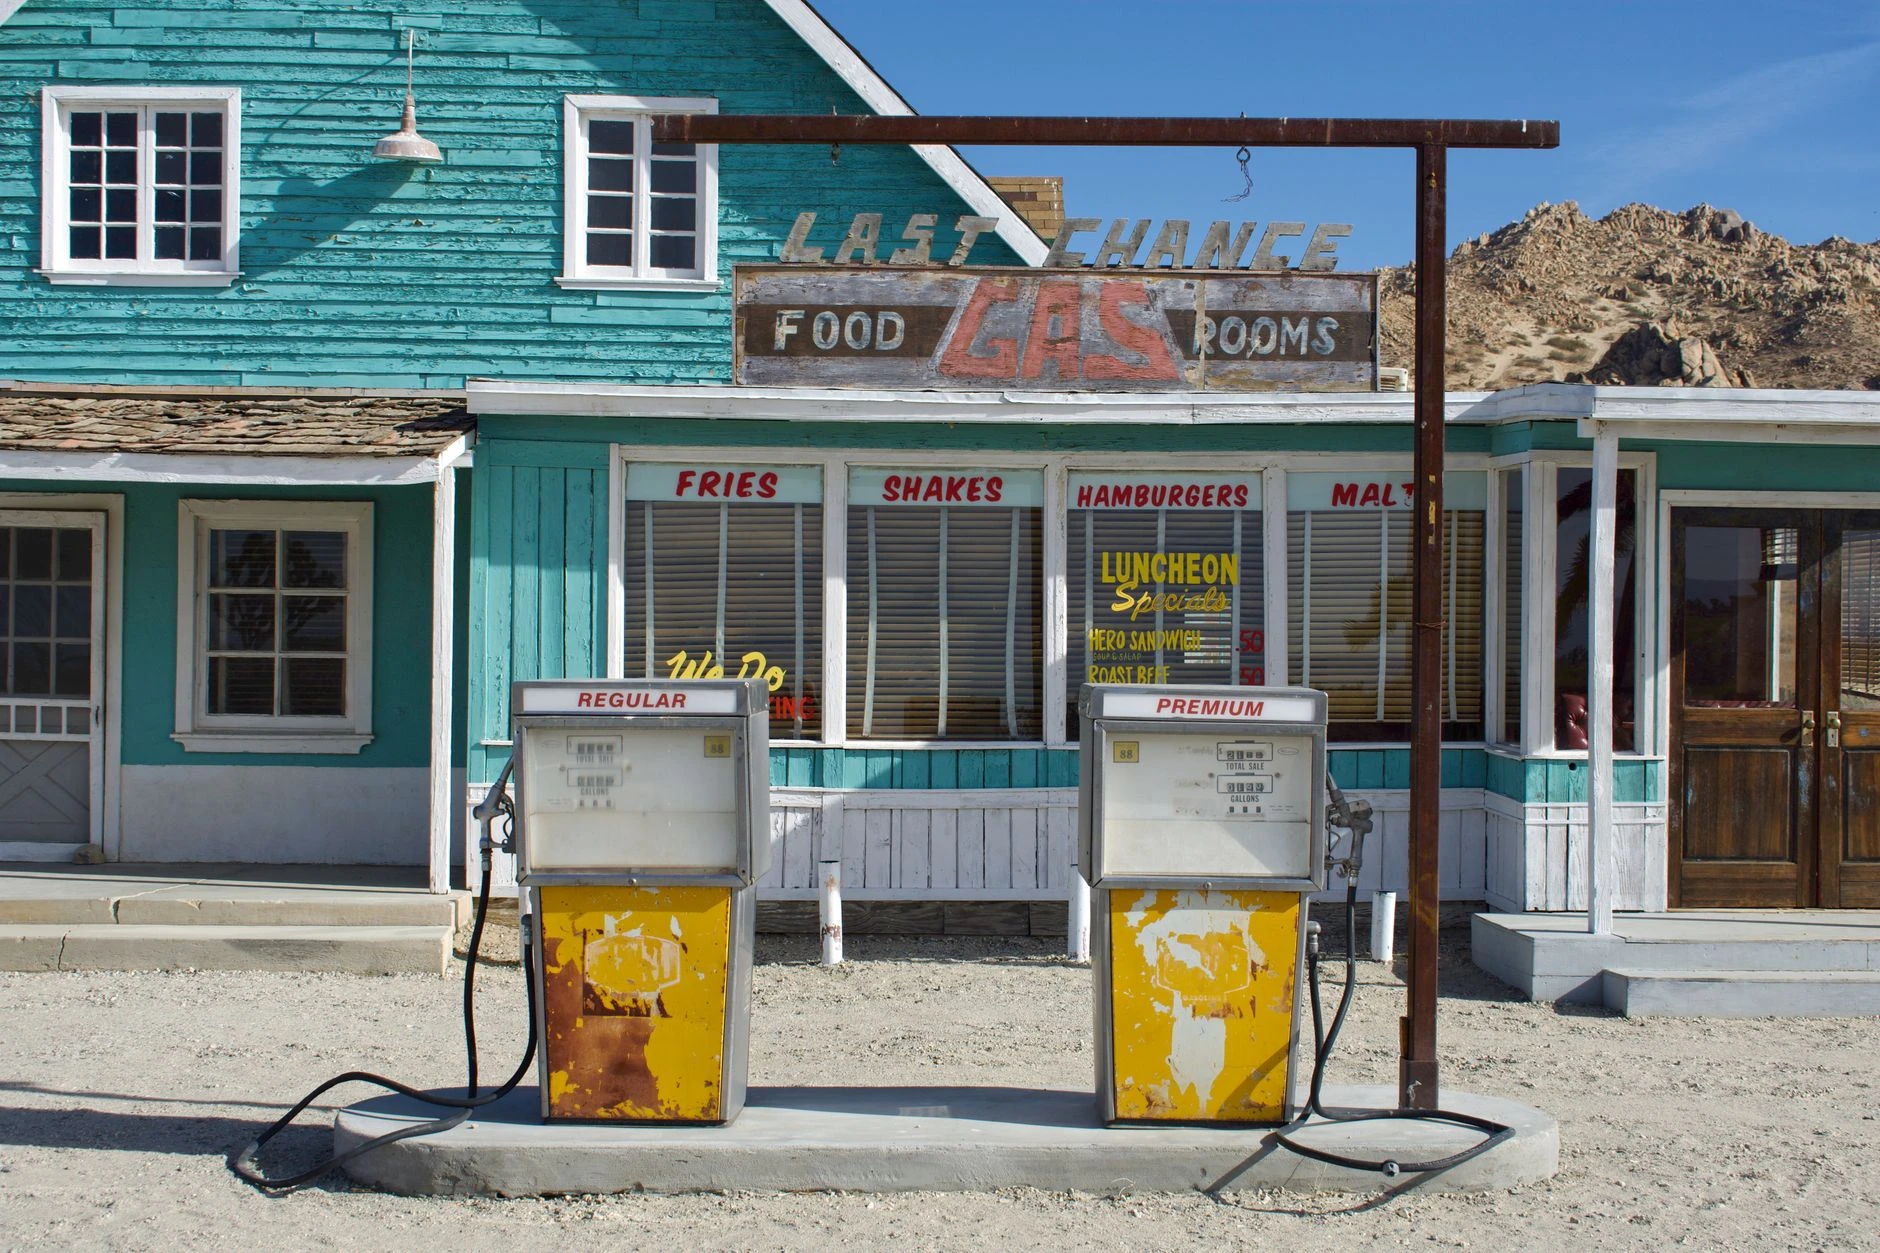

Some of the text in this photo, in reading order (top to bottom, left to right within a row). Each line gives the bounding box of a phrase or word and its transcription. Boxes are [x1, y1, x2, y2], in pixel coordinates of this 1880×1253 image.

[779, 212, 1354, 271] LAST CHANCE
[774, 276, 1340, 381] FOOD GAS ROOMS
[676, 470, 778, 498] FRIES
[882, 475, 1003, 502] SHAKES
[1077, 484, 1249, 508] HAMBURGERS
[1101, 551, 1240, 586] LUNCHEON
[1111, 581, 1231, 621] Specials
[1088, 629, 1126, 652] HERO
[1130, 629, 1201, 652] SANDWICH
[737, 651, 787, 692] Do
[1088, 665, 1133, 684] ROAST
[1137, 666, 1170, 684] BEEF
[577, 692, 687, 708] REGULAR
[768, 696, 816, 720] ING
[1156, 698, 1265, 716] PREMIUM
[1119, 749, 1133, 760] 88
[1226, 762, 1265, 770] TOTAL SALE
[1230, 794, 1260, 803] GALLONS
